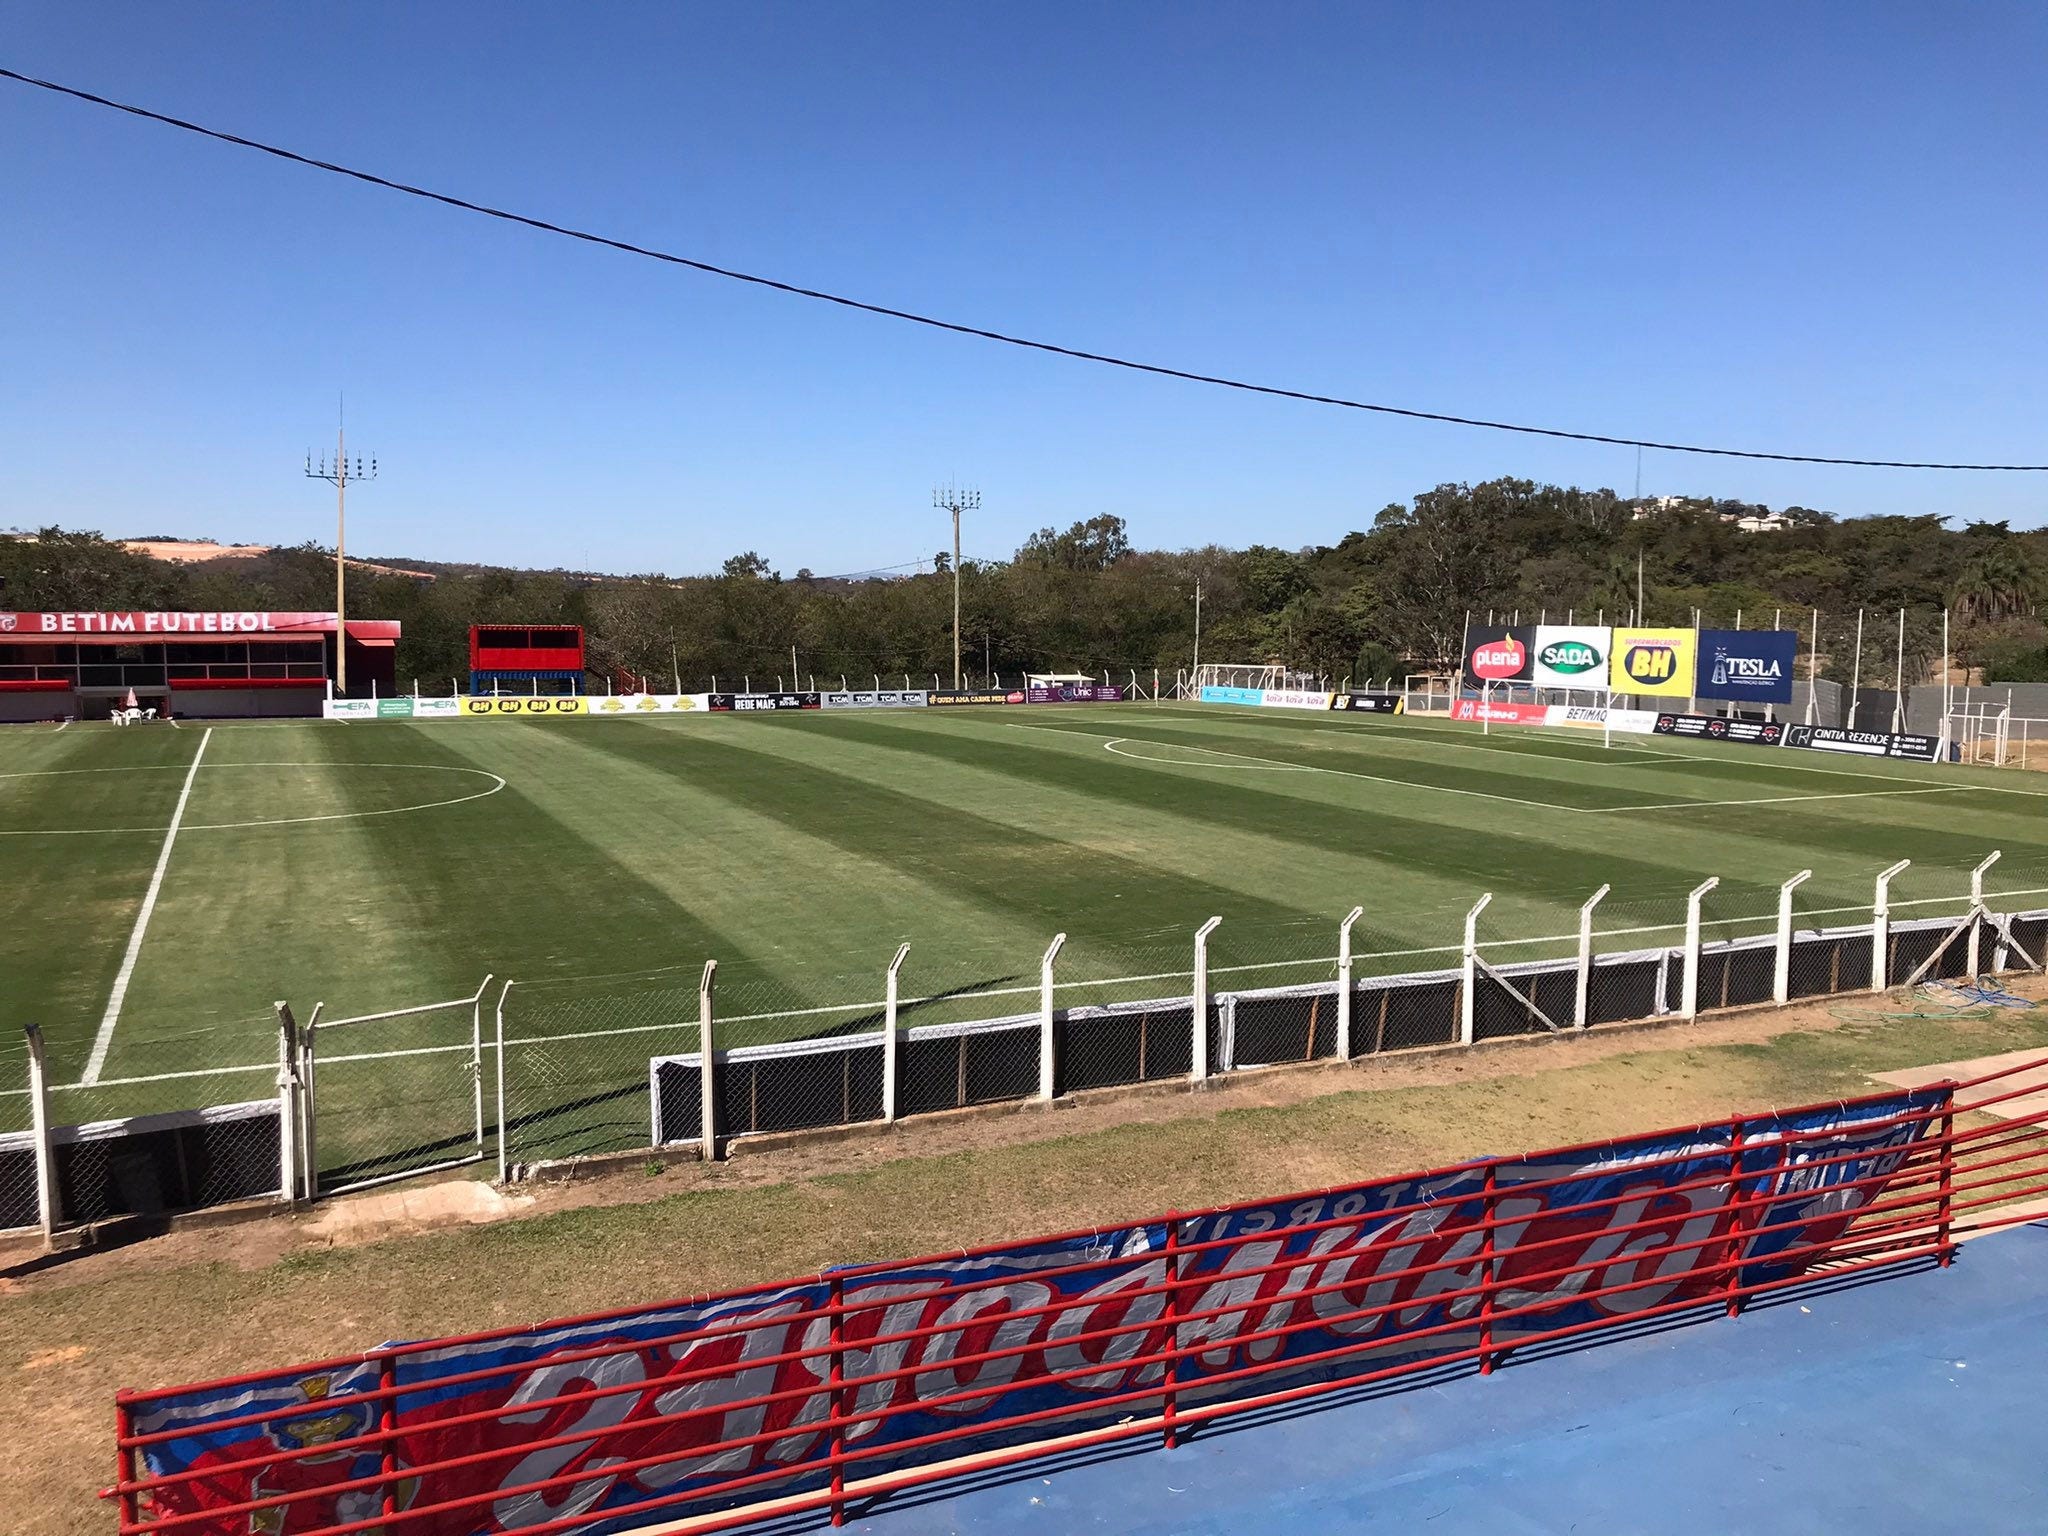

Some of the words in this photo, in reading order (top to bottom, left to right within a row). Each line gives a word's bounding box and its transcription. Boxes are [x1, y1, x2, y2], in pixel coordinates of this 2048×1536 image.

[41, 613, 136, 632] BETIM
[144, 612, 276, 632] FUTEBOL
[1476, 651, 1520, 668] plena
[1544, 648, 1595, 665] SADA
[1631, 648, 1672, 678] BH
[1725, 658, 1782, 677] TESLA
[734, 699, 755, 710] REDE
[756, 698, 776, 709] MAIS
